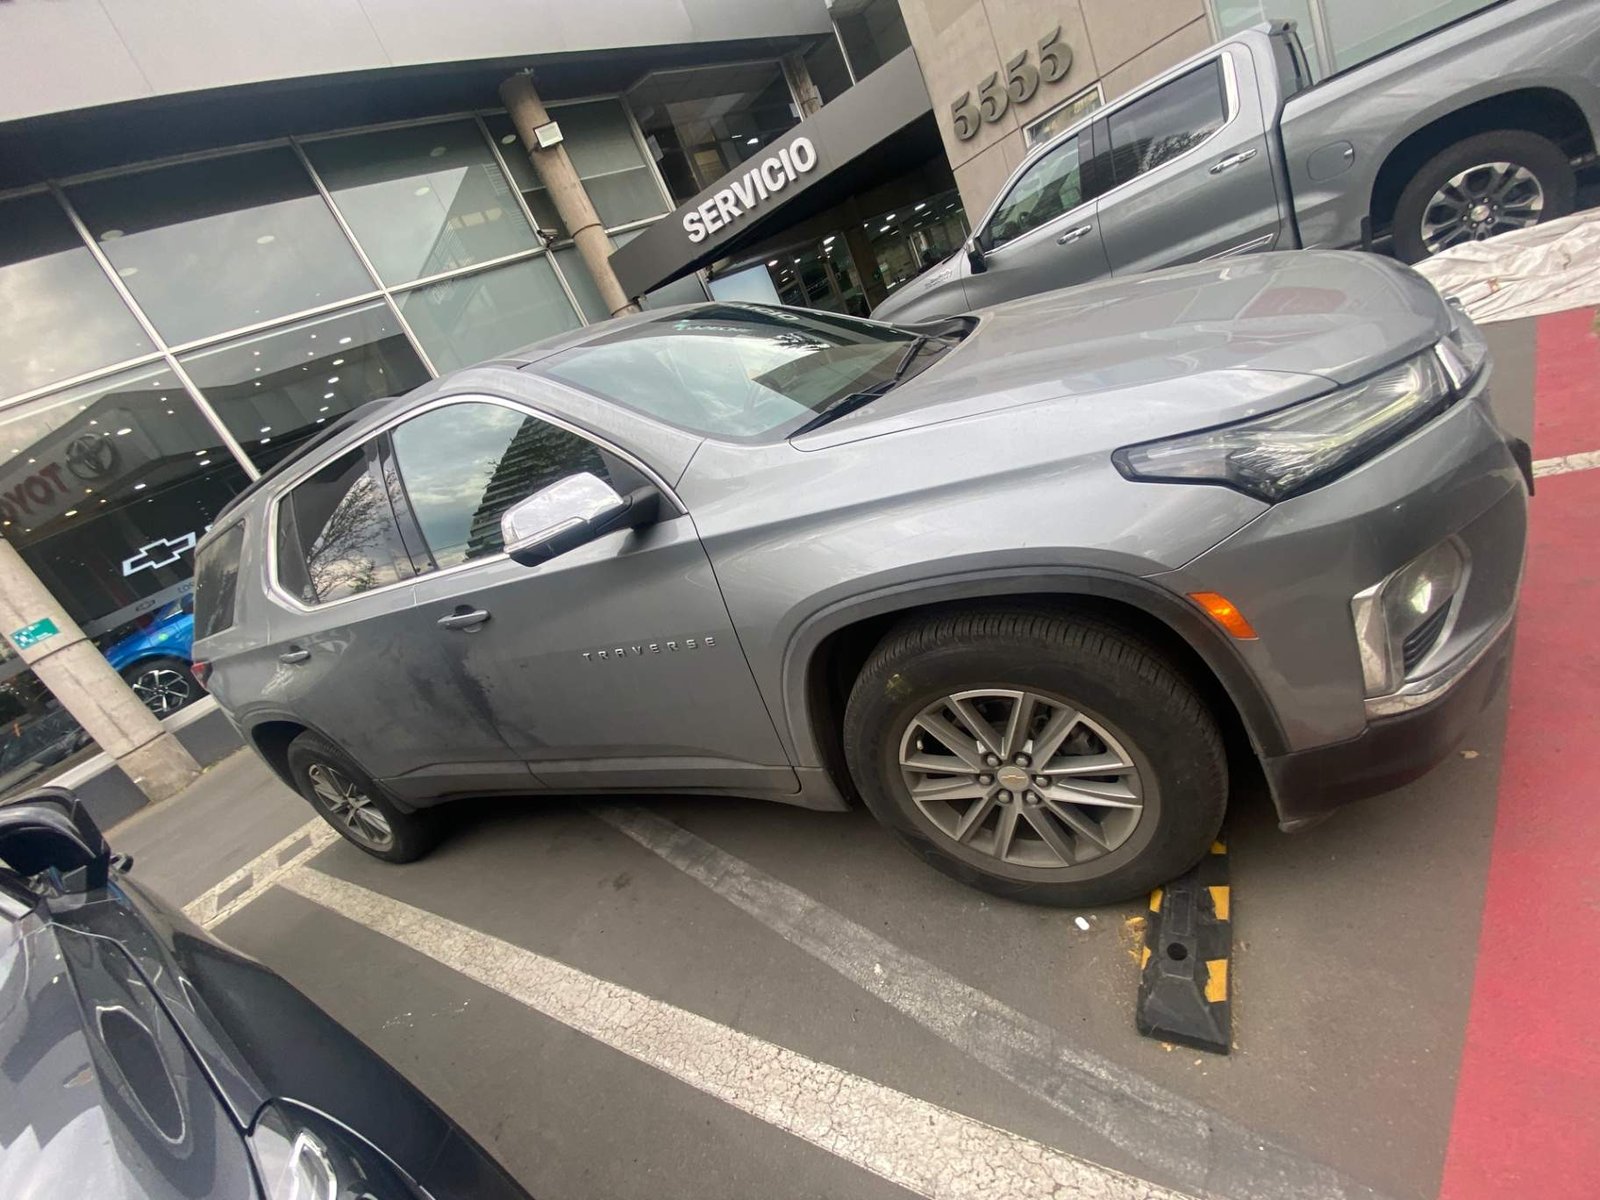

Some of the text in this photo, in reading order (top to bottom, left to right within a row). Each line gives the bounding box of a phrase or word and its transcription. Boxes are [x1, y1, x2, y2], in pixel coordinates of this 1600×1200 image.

[950, 25, 1073, 141] 5555
[682, 136, 817, 243] SERVICIO
[582, 636, 716, 662] TRAVERSE
